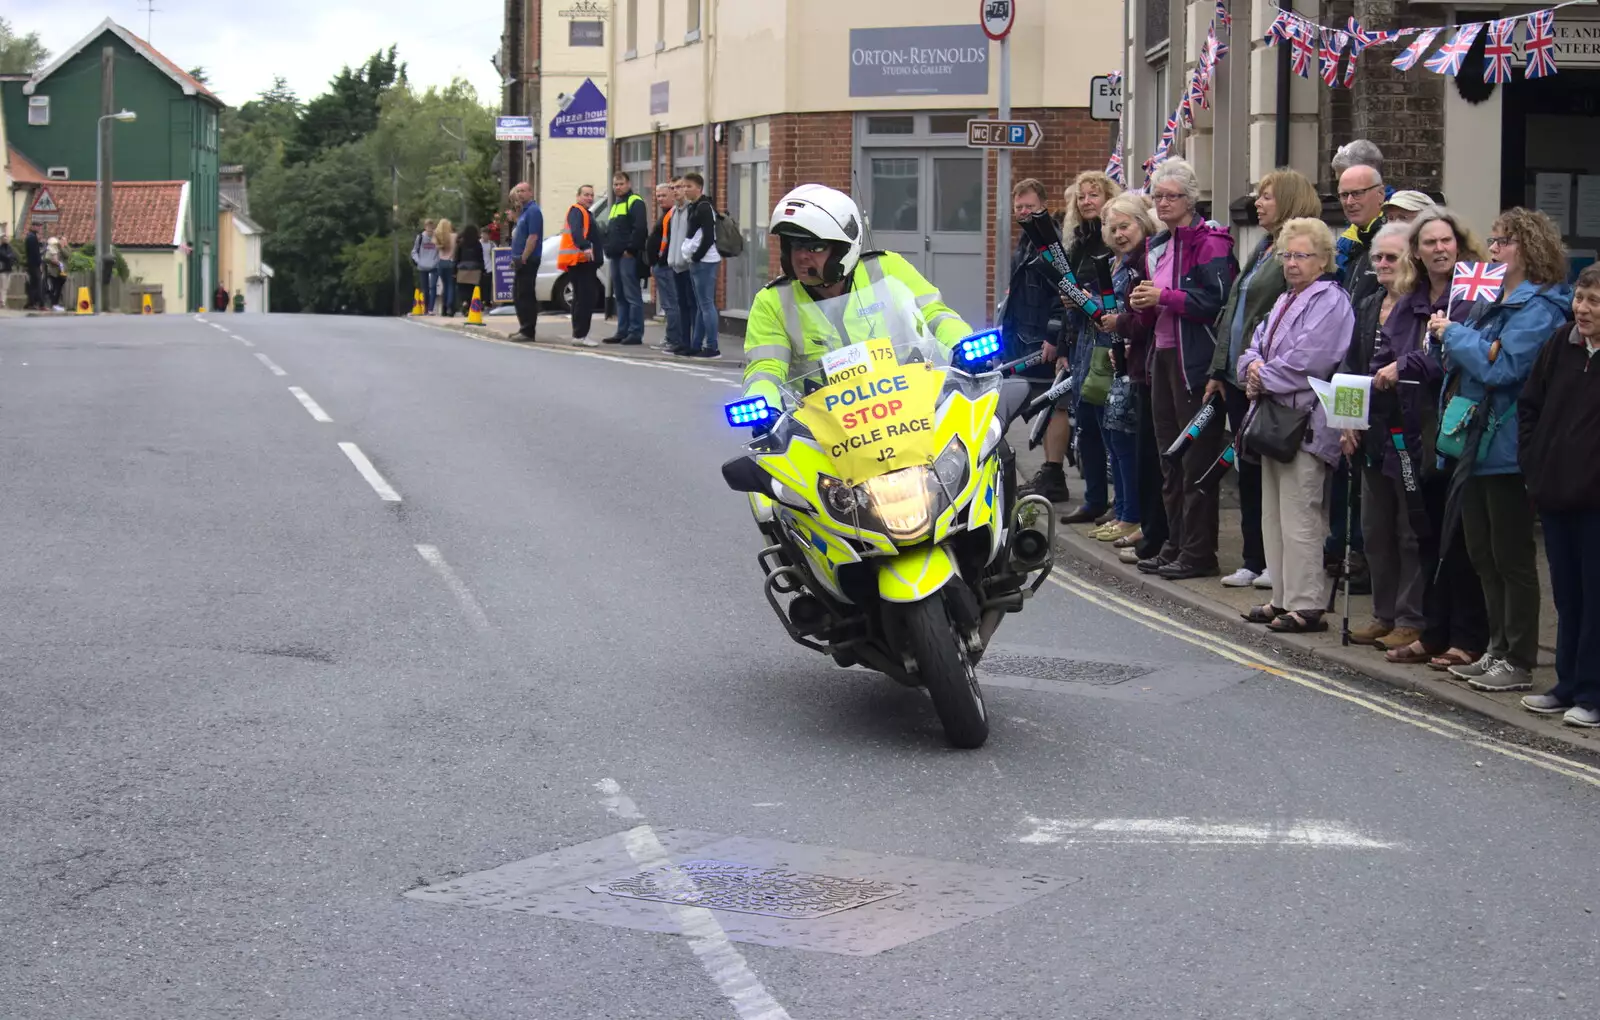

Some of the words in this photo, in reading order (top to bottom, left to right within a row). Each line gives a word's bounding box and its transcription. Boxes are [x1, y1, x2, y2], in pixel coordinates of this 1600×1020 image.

[1572, 27, 1600, 39] AND
[852, 47, 985, 66] ORTON-REYNOLDS
[882, 65, 911, 75] STUDIO
[912, 64, 919, 75] &
[920, 64, 953, 75] GALLERY
[555, 113, 583, 127] pizza
[974, 128, 987, 139] WC
[1011, 127, 1022, 141] P
[1058, 280, 1086, 306] GENESIS
[1062, 277, 1089, 302] MADISON
[870, 347, 893, 361] 175
[829, 364, 868, 385] MOTO
[824, 375, 909, 412] POLICE
[842, 399, 903, 430] STOP
[831, 428, 882, 459] CYCLE
[887, 418, 931, 438] RACE
[876, 446, 896, 463] J2
